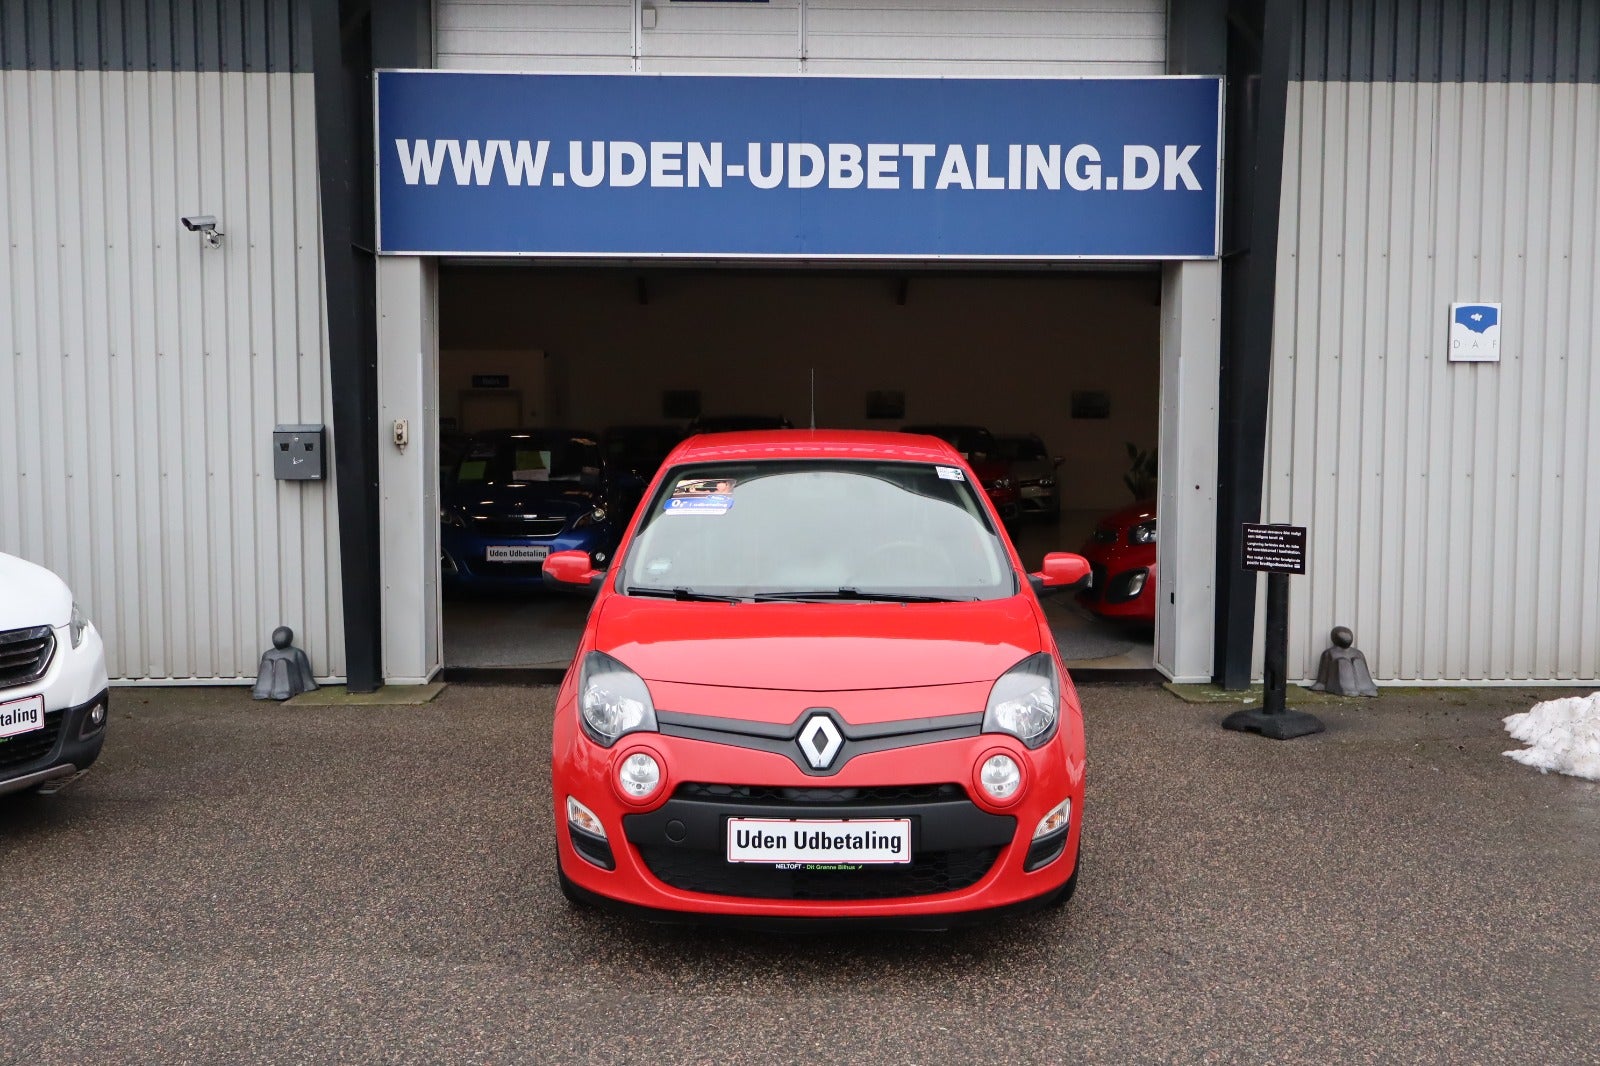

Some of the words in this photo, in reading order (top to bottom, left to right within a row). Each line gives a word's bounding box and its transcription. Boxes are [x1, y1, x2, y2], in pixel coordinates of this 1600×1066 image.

[395, 138, 1202, 192] WWW.UDEN-UDBETALING.DK
[489, 549, 508, 558] Uden
[509, 549, 547, 559] Udbetaling
[736, 829, 787, 849] Uden
[794, 831, 902, 853] Udbetaling
